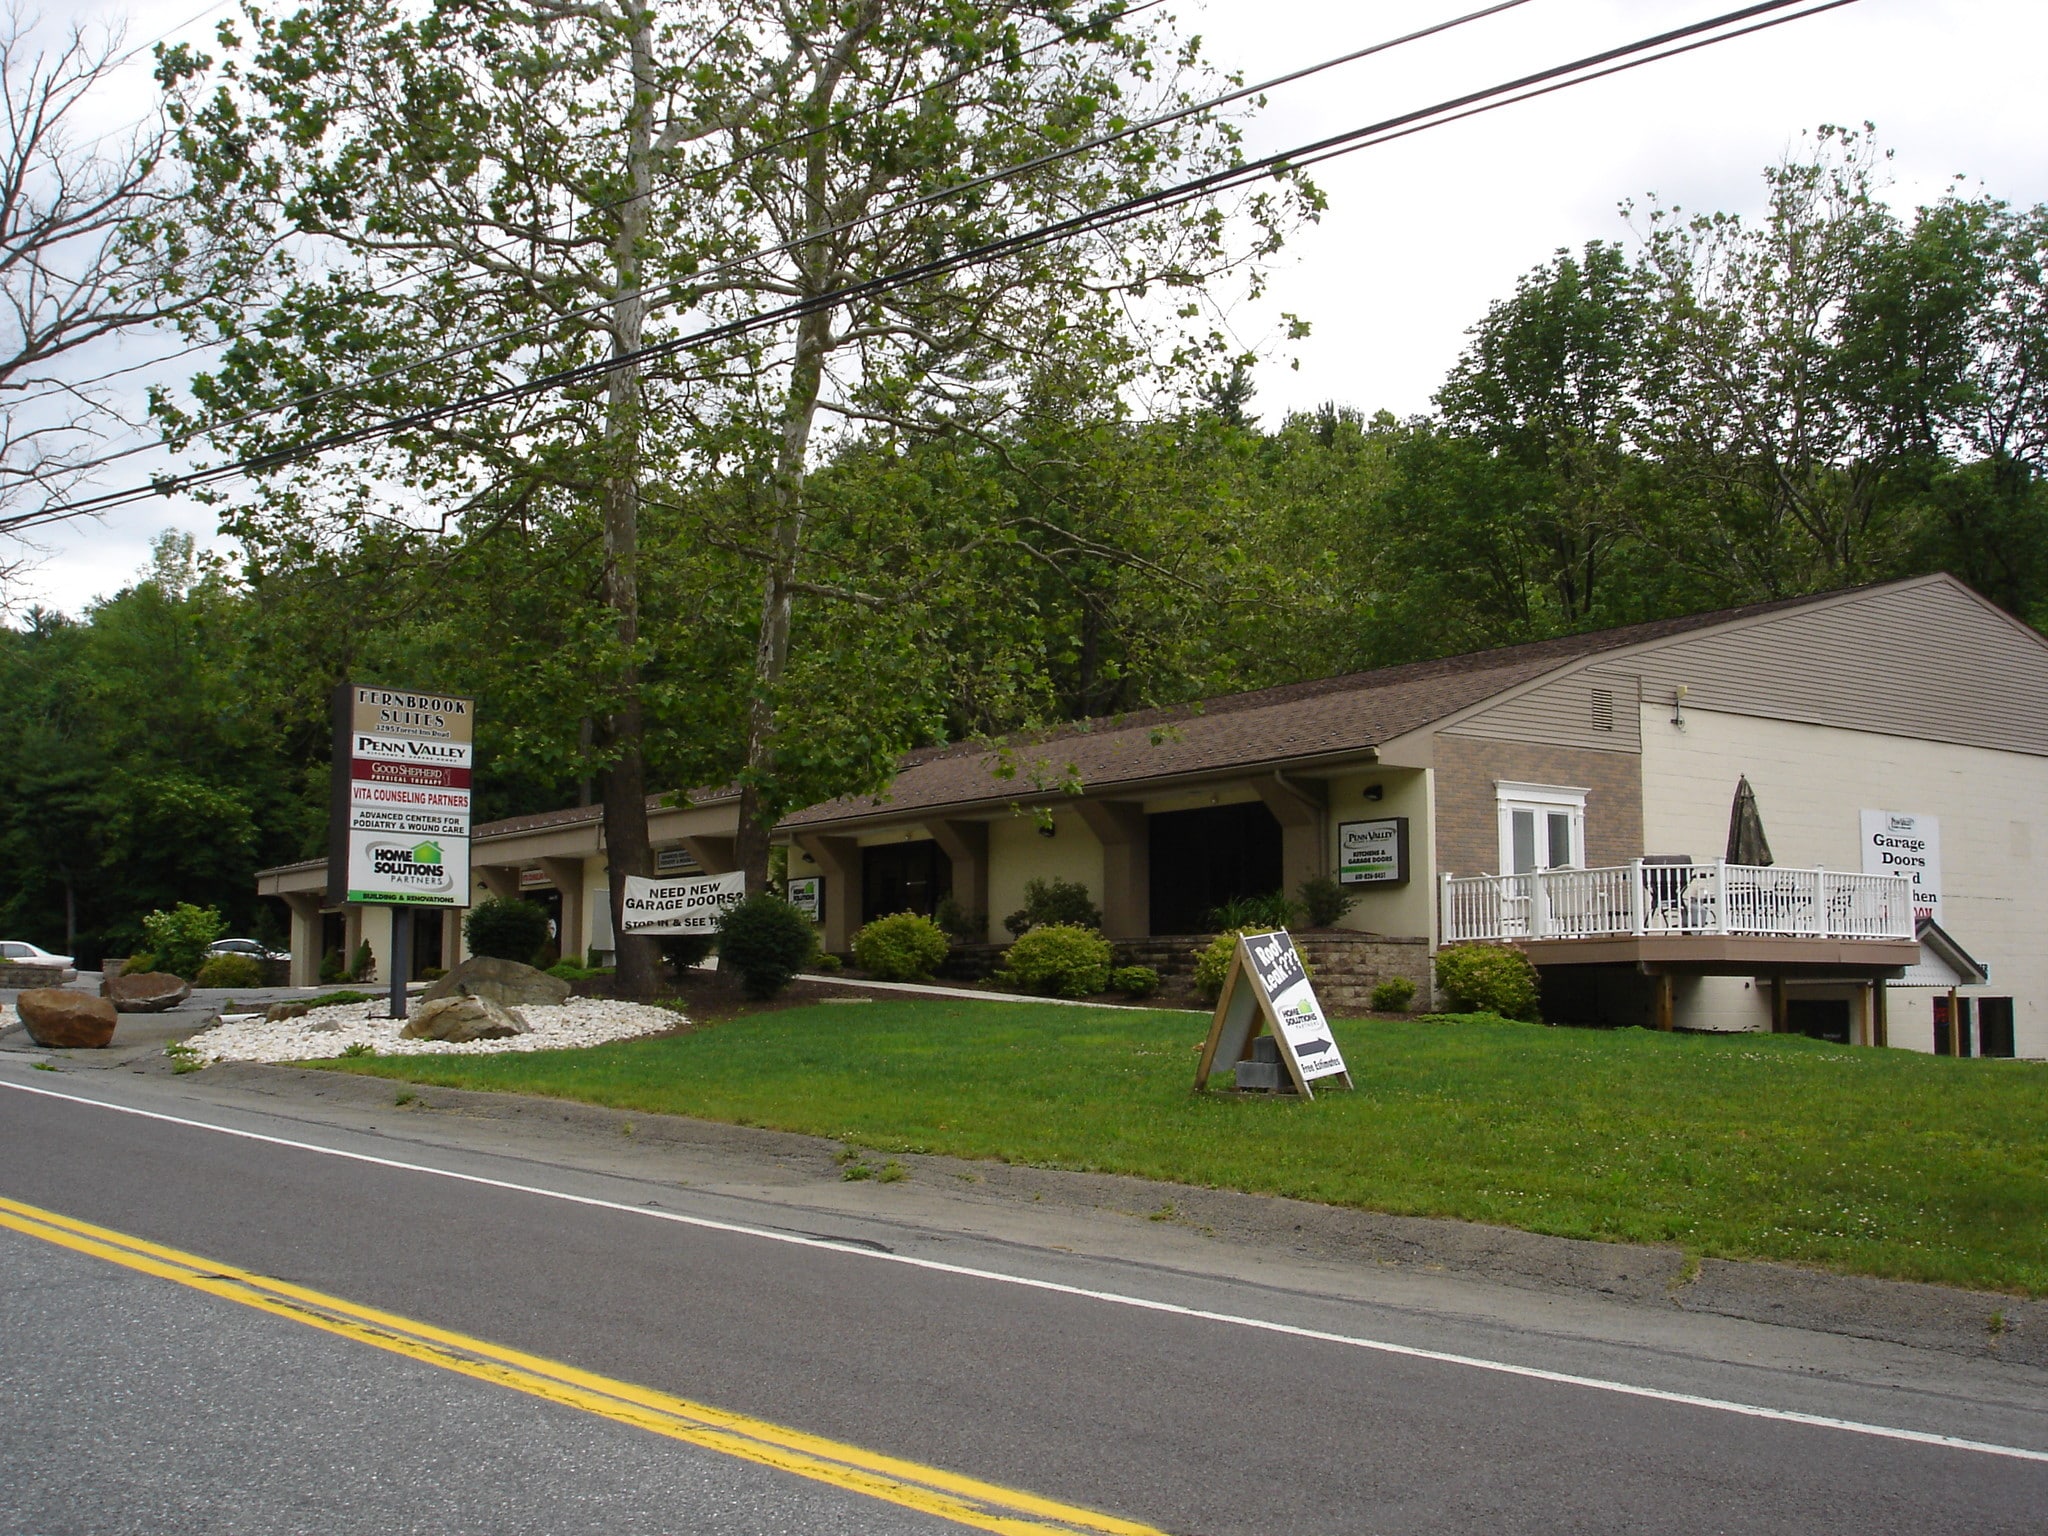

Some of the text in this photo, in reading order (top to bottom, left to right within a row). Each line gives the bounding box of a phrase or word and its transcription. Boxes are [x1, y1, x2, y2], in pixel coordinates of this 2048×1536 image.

[359, 690, 466, 714] FERNBROOK
[380, 709, 445, 728] SUITES
[419, 728, 431, 736] Inn
[432, 730, 450, 738] Road
[359, 737, 466, 758] PENN VALLEY
[372, 762, 443, 778] GOOD SHEPHERD
[371, 775, 442, 785] PHYSICAL THERAPY
[353, 787, 469, 808] VITA COUNSELING PARTNERS
[359, 811, 460, 825] ADVANCED CENTERS FOR
[353, 820, 397, 829] PODIATRY
[408, 823, 440, 832] WOUND
[442, 826, 465, 834] CARE
[1873, 833, 1925, 852] Garage
[375, 848, 412, 862] HOME
[1882, 852, 1925, 867] Doors
[374, 862, 444, 877] SOLUTIONS
[391, 876, 443, 885] PARTNERS
[363, 893, 397, 901] BUILDING
[407, 895, 454, 903] RENOVATIONS
[650, 882, 721, 899] NEED NEW
[625, 892, 744, 911] GARAGE DOORS?
[658, 919, 669, 927] IN
[672, 919, 681, 927] &
[684, 917, 706, 927] SEE
[1255, 934, 1283, 967] Roof
[1281, 1008, 1300, 1018] HOME
[1285, 1013, 1318, 1026] SOLUTIONS
